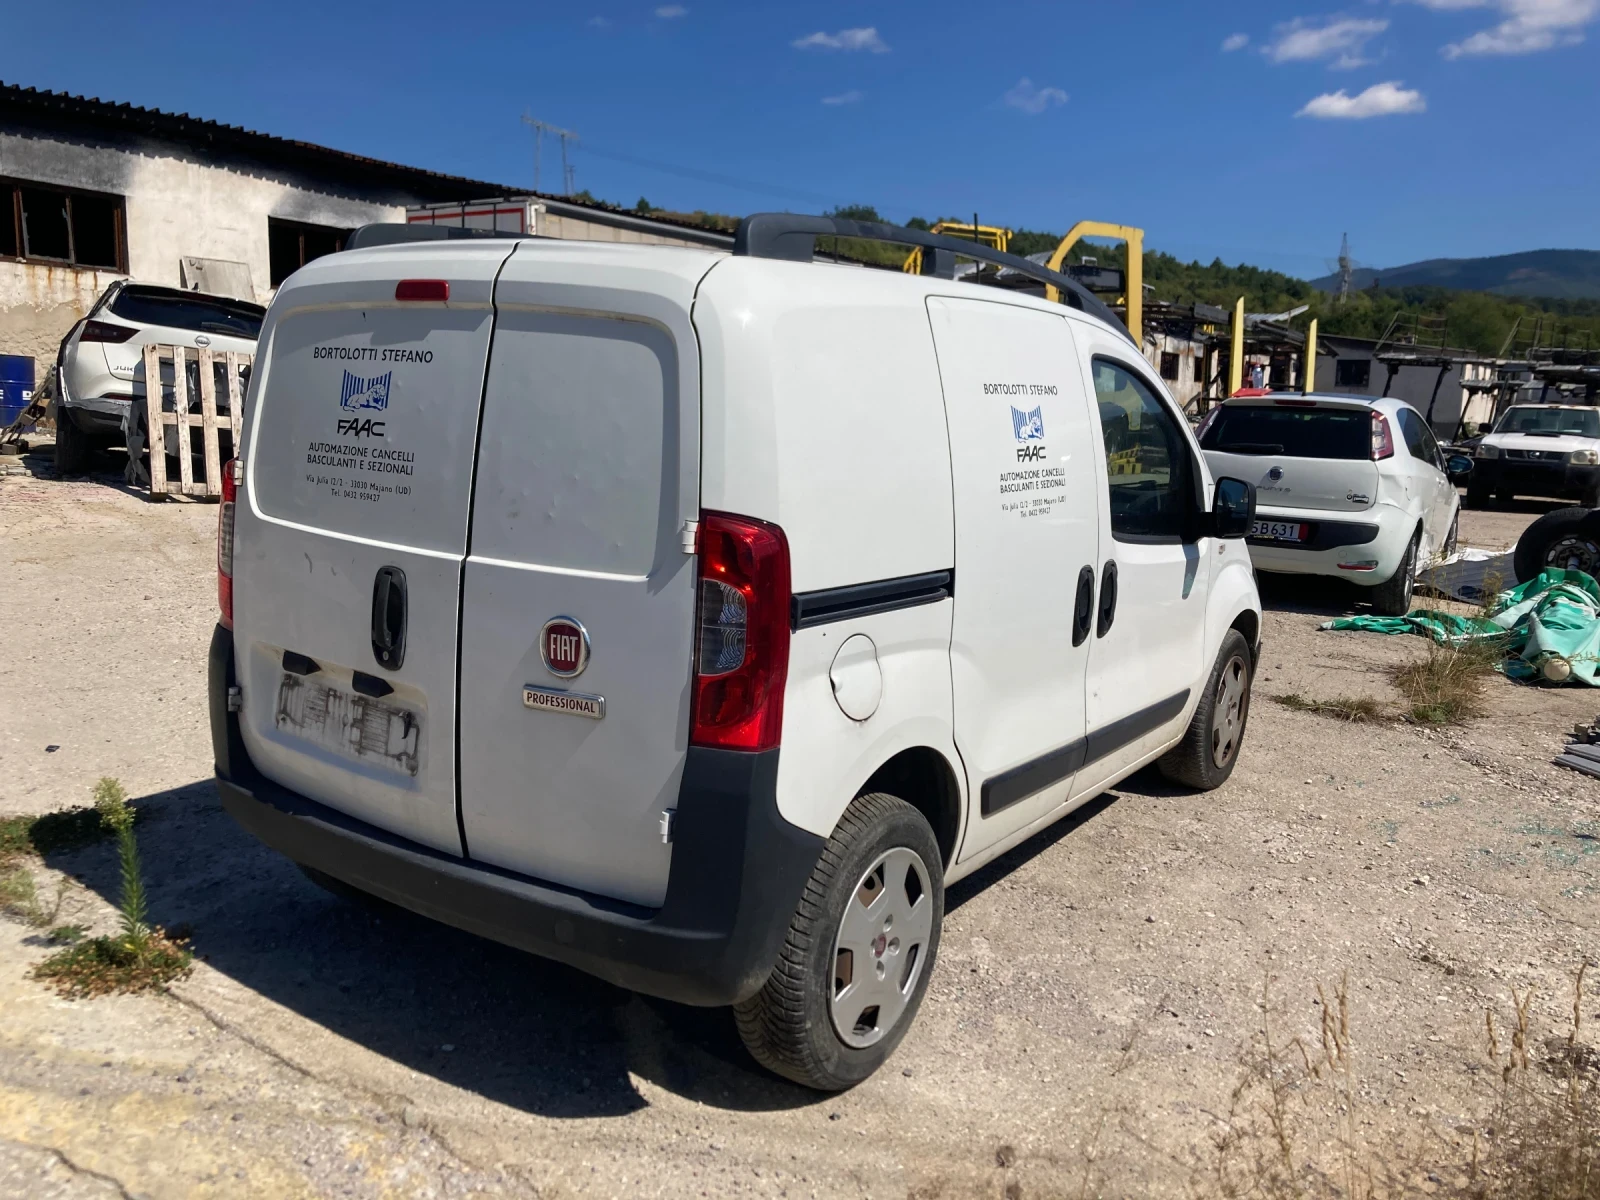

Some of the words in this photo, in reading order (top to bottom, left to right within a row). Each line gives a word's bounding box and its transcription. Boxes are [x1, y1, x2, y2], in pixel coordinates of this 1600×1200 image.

[313, 347, 377, 361] BORTOLOTTI
[381, 349, 433, 364] STEFANO
[983, 383, 1028, 395] BORTOLOTTI
[1030, 384, 1058, 396] STEFANO
[337, 418, 385, 437] FAAC
[308, 442, 368, 457] AUTOMAZIONE
[371, 448, 415, 462] CANCELLI
[1017, 445, 1047, 463] FAAC
[307, 455, 356, 469] BASCULANTI
[359, 459, 364, 470] E
[367, 460, 414, 476] SEZIONALI
[1000, 470, 1040, 482] AUTOMAZIONE
[1041, 467, 1065, 478] CANCELLI
[306, 474, 315, 483] Via
[316, 476, 329, 485] Julia
[330, 477, 343, 487] 12/2
[350, 480, 368, 490] 33030
[369, 483, 393, 493] Majano
[395, 485, 412, 496] (UD)
[1000, 480, 1035, 494] BASCULANTI
[1040, 478, 1066, 489] SEZIONALI
[343, 489, 357, 499] 0432
[359, 491, 381, 502] 959427
[550, 633, 578, 662] FIAT
[527, 692, 596, 713] PROFESSIONAL
